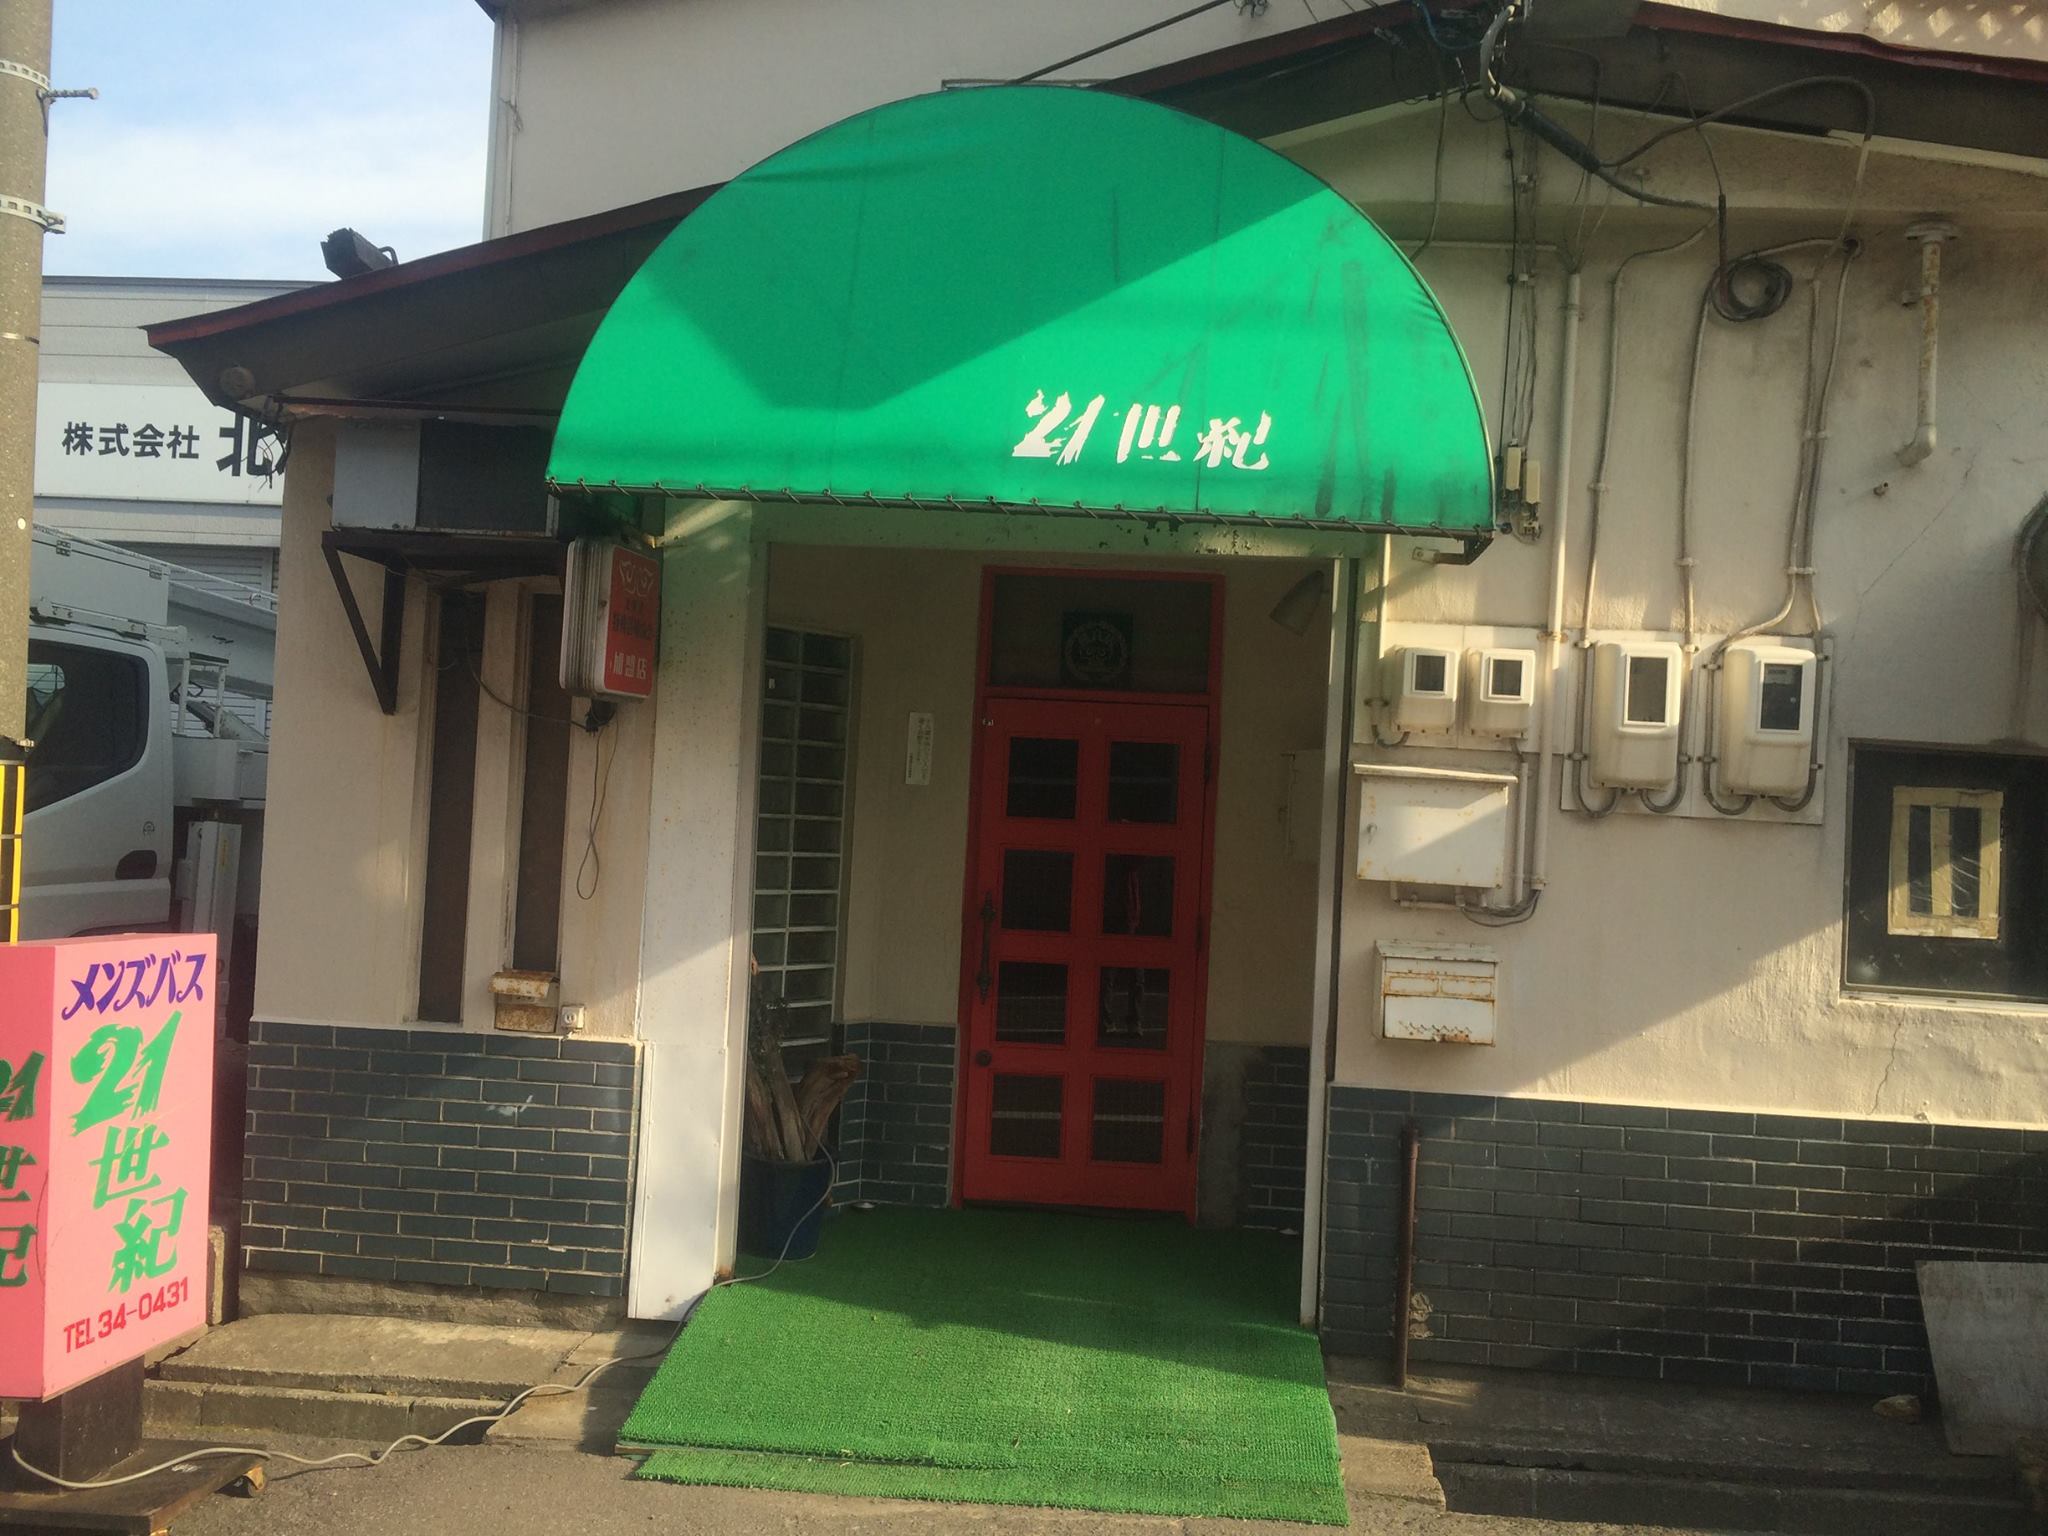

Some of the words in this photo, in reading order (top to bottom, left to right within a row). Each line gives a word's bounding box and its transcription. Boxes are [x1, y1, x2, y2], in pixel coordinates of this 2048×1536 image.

[61, 421, 201, 459] 株式会社
[61, 951, 208, 1020] メンズバス
[97, 1276, 189, 1339] 34-0431
